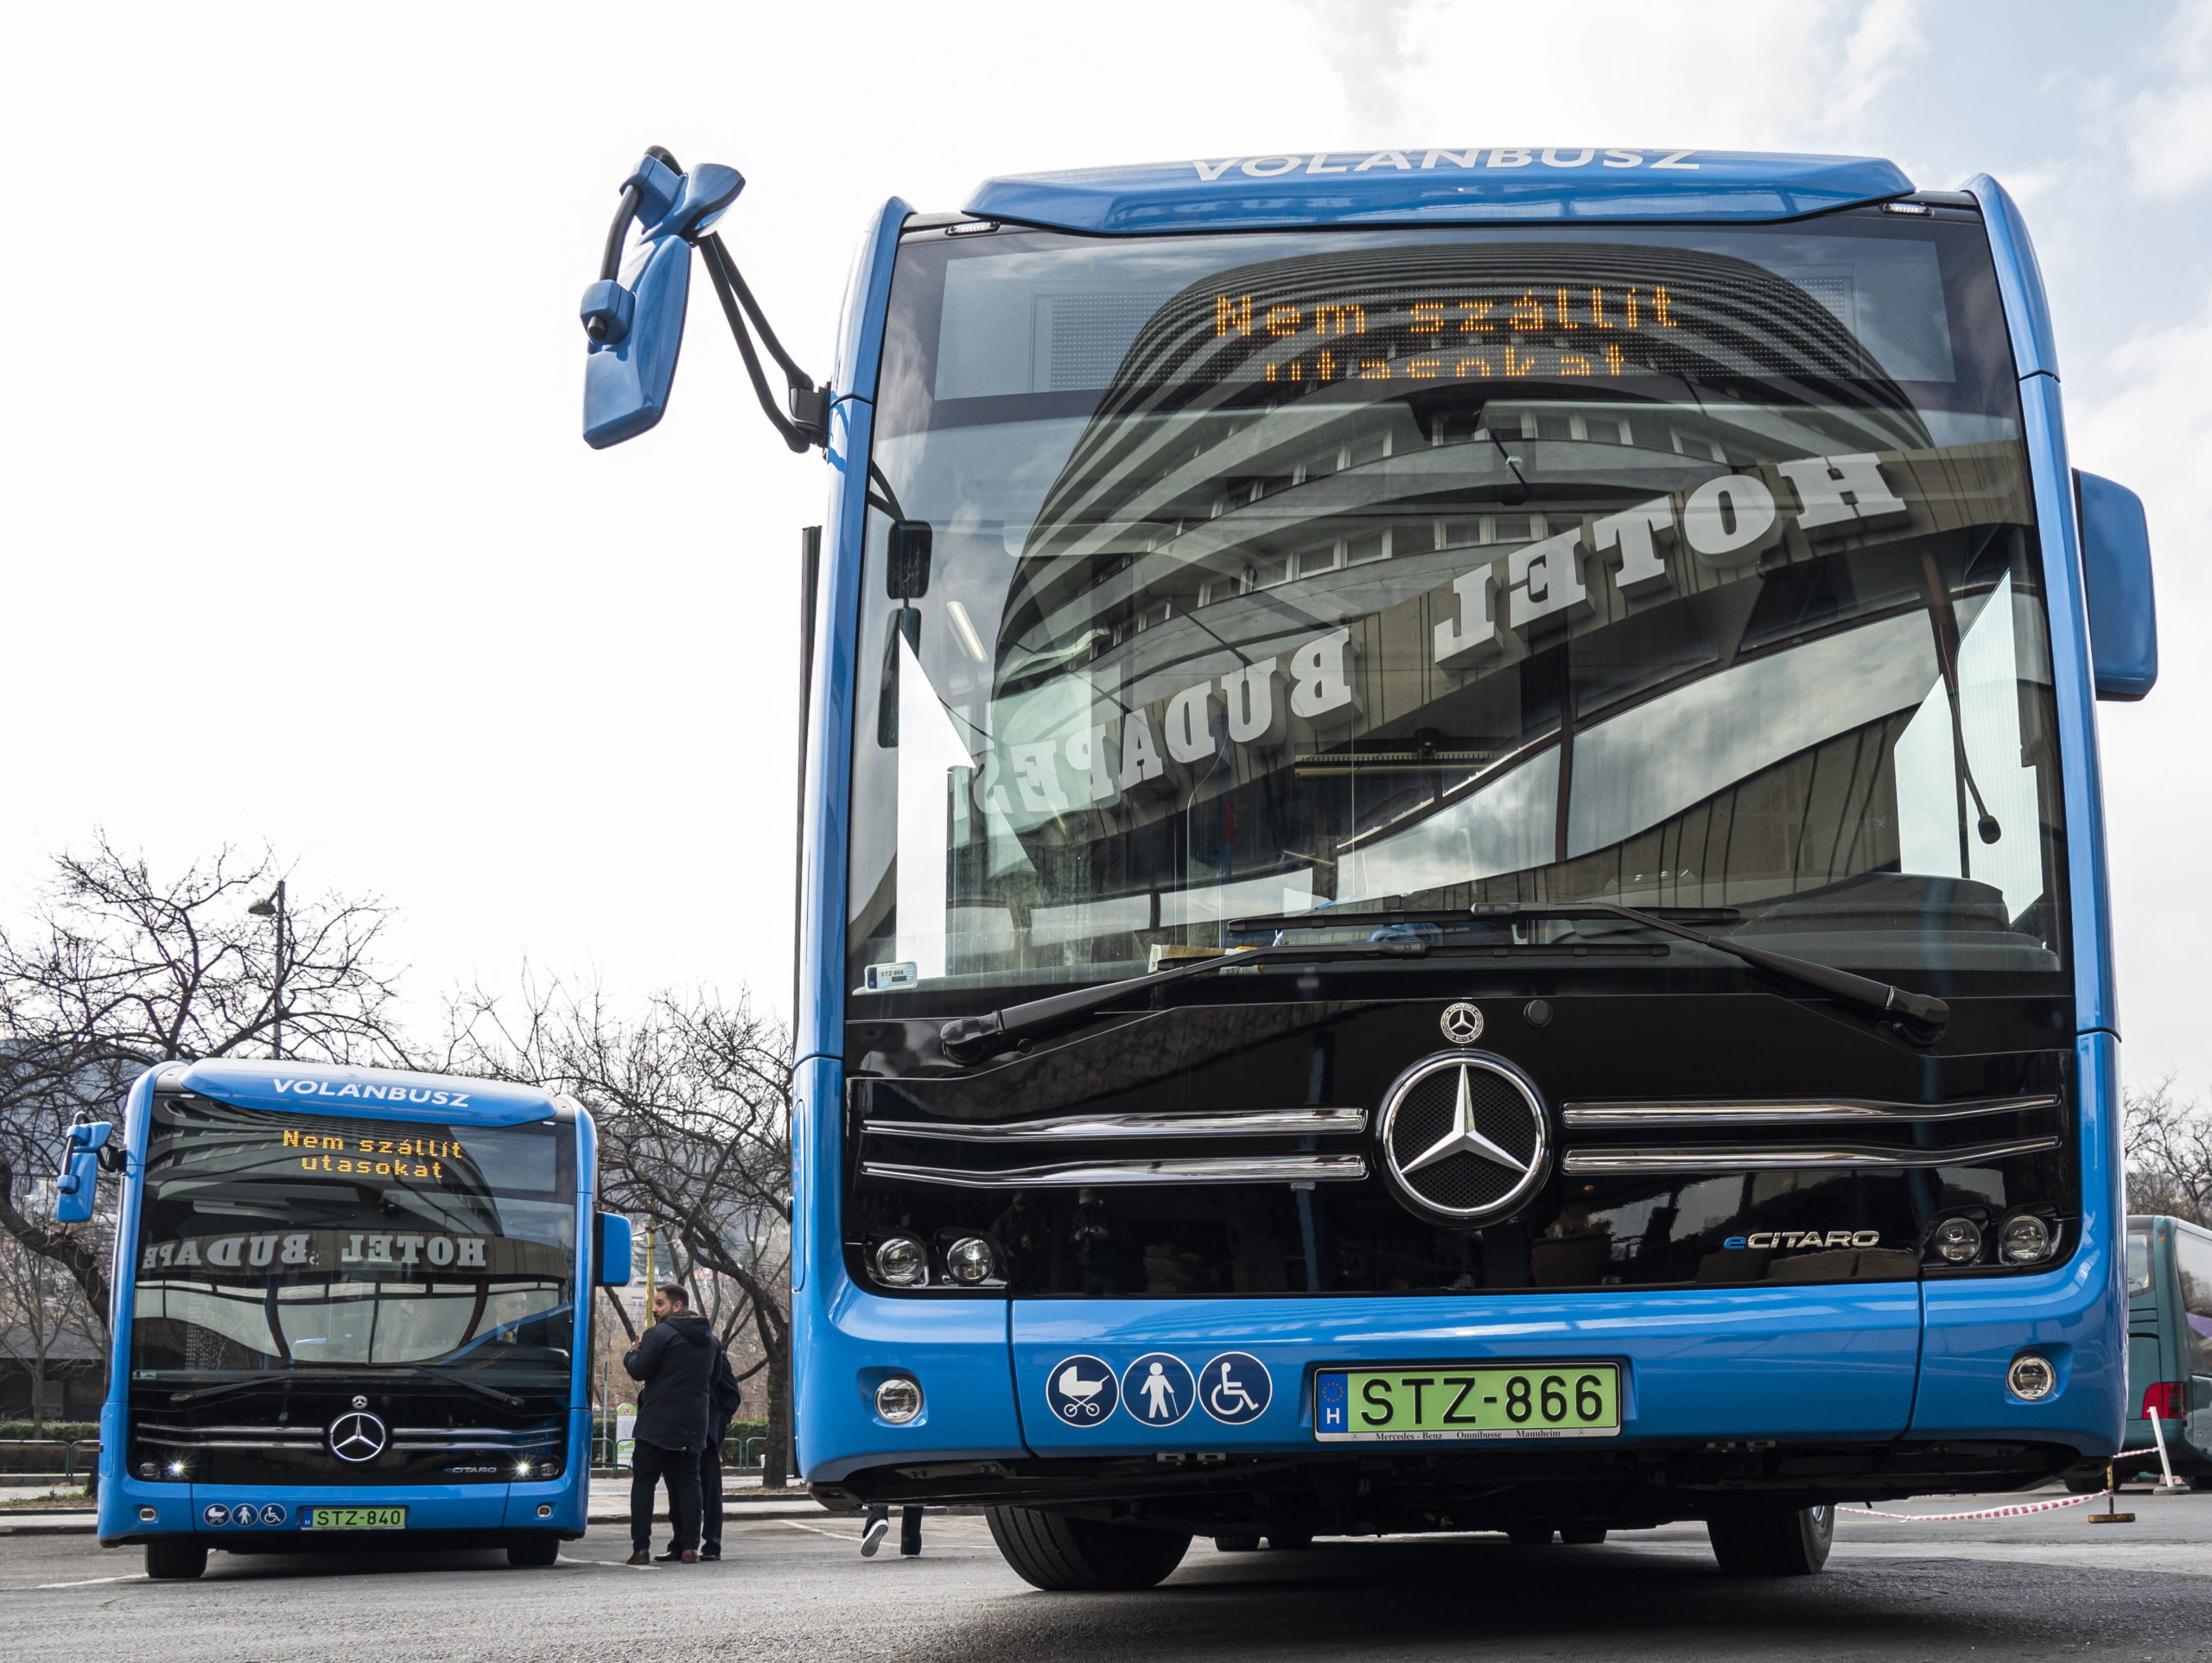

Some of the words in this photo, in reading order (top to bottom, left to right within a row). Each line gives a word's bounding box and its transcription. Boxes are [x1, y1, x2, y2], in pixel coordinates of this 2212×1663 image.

[1217, 294, 1365, 337] Nem
[1409, 285, 1677, 333] szállít
[283, 1129, 345, 1150] Nem
[359, 1138, 462, 1158] szállít
[302, 1154, 443, 1178] utasokat
[1723, 1229, 1880, 1250] eCITARO
[1325, 1407, 1341, 1425] H
[1360, 1374, 1603, 1425] STZ-866
[1422, 1431, 1443, 1440] Benz
[1456, 1431, 1503, 1439] Omnibusse
[1516, 1429, 1561, 1438] Mannheim
[316, 1509, 401, 1526] STZ-840
